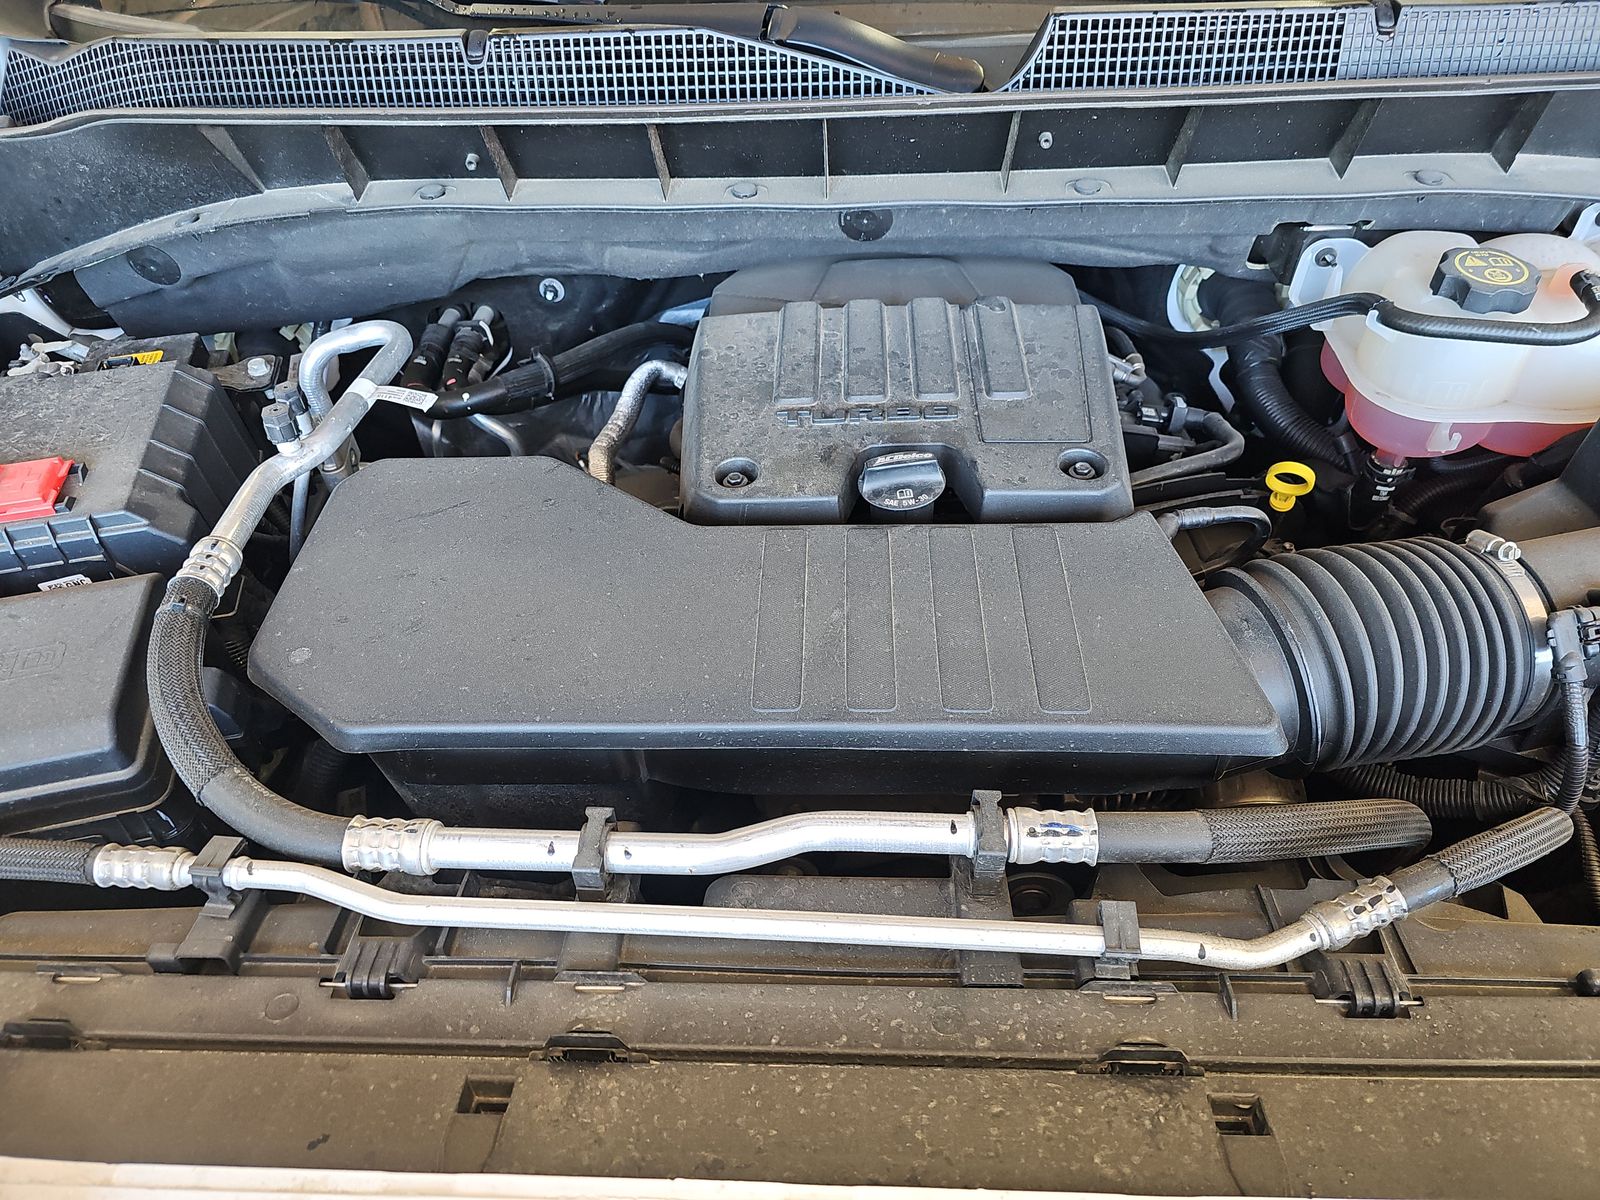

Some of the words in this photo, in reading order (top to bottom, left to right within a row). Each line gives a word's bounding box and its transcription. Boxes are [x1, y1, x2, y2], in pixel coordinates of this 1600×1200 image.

[776, 405, 959, 427] TURBO
[872, 453, 933, 467] ACDelco
[883, 498, 899, 507] SAE
[902, 494, 929, 507] 5W-30
